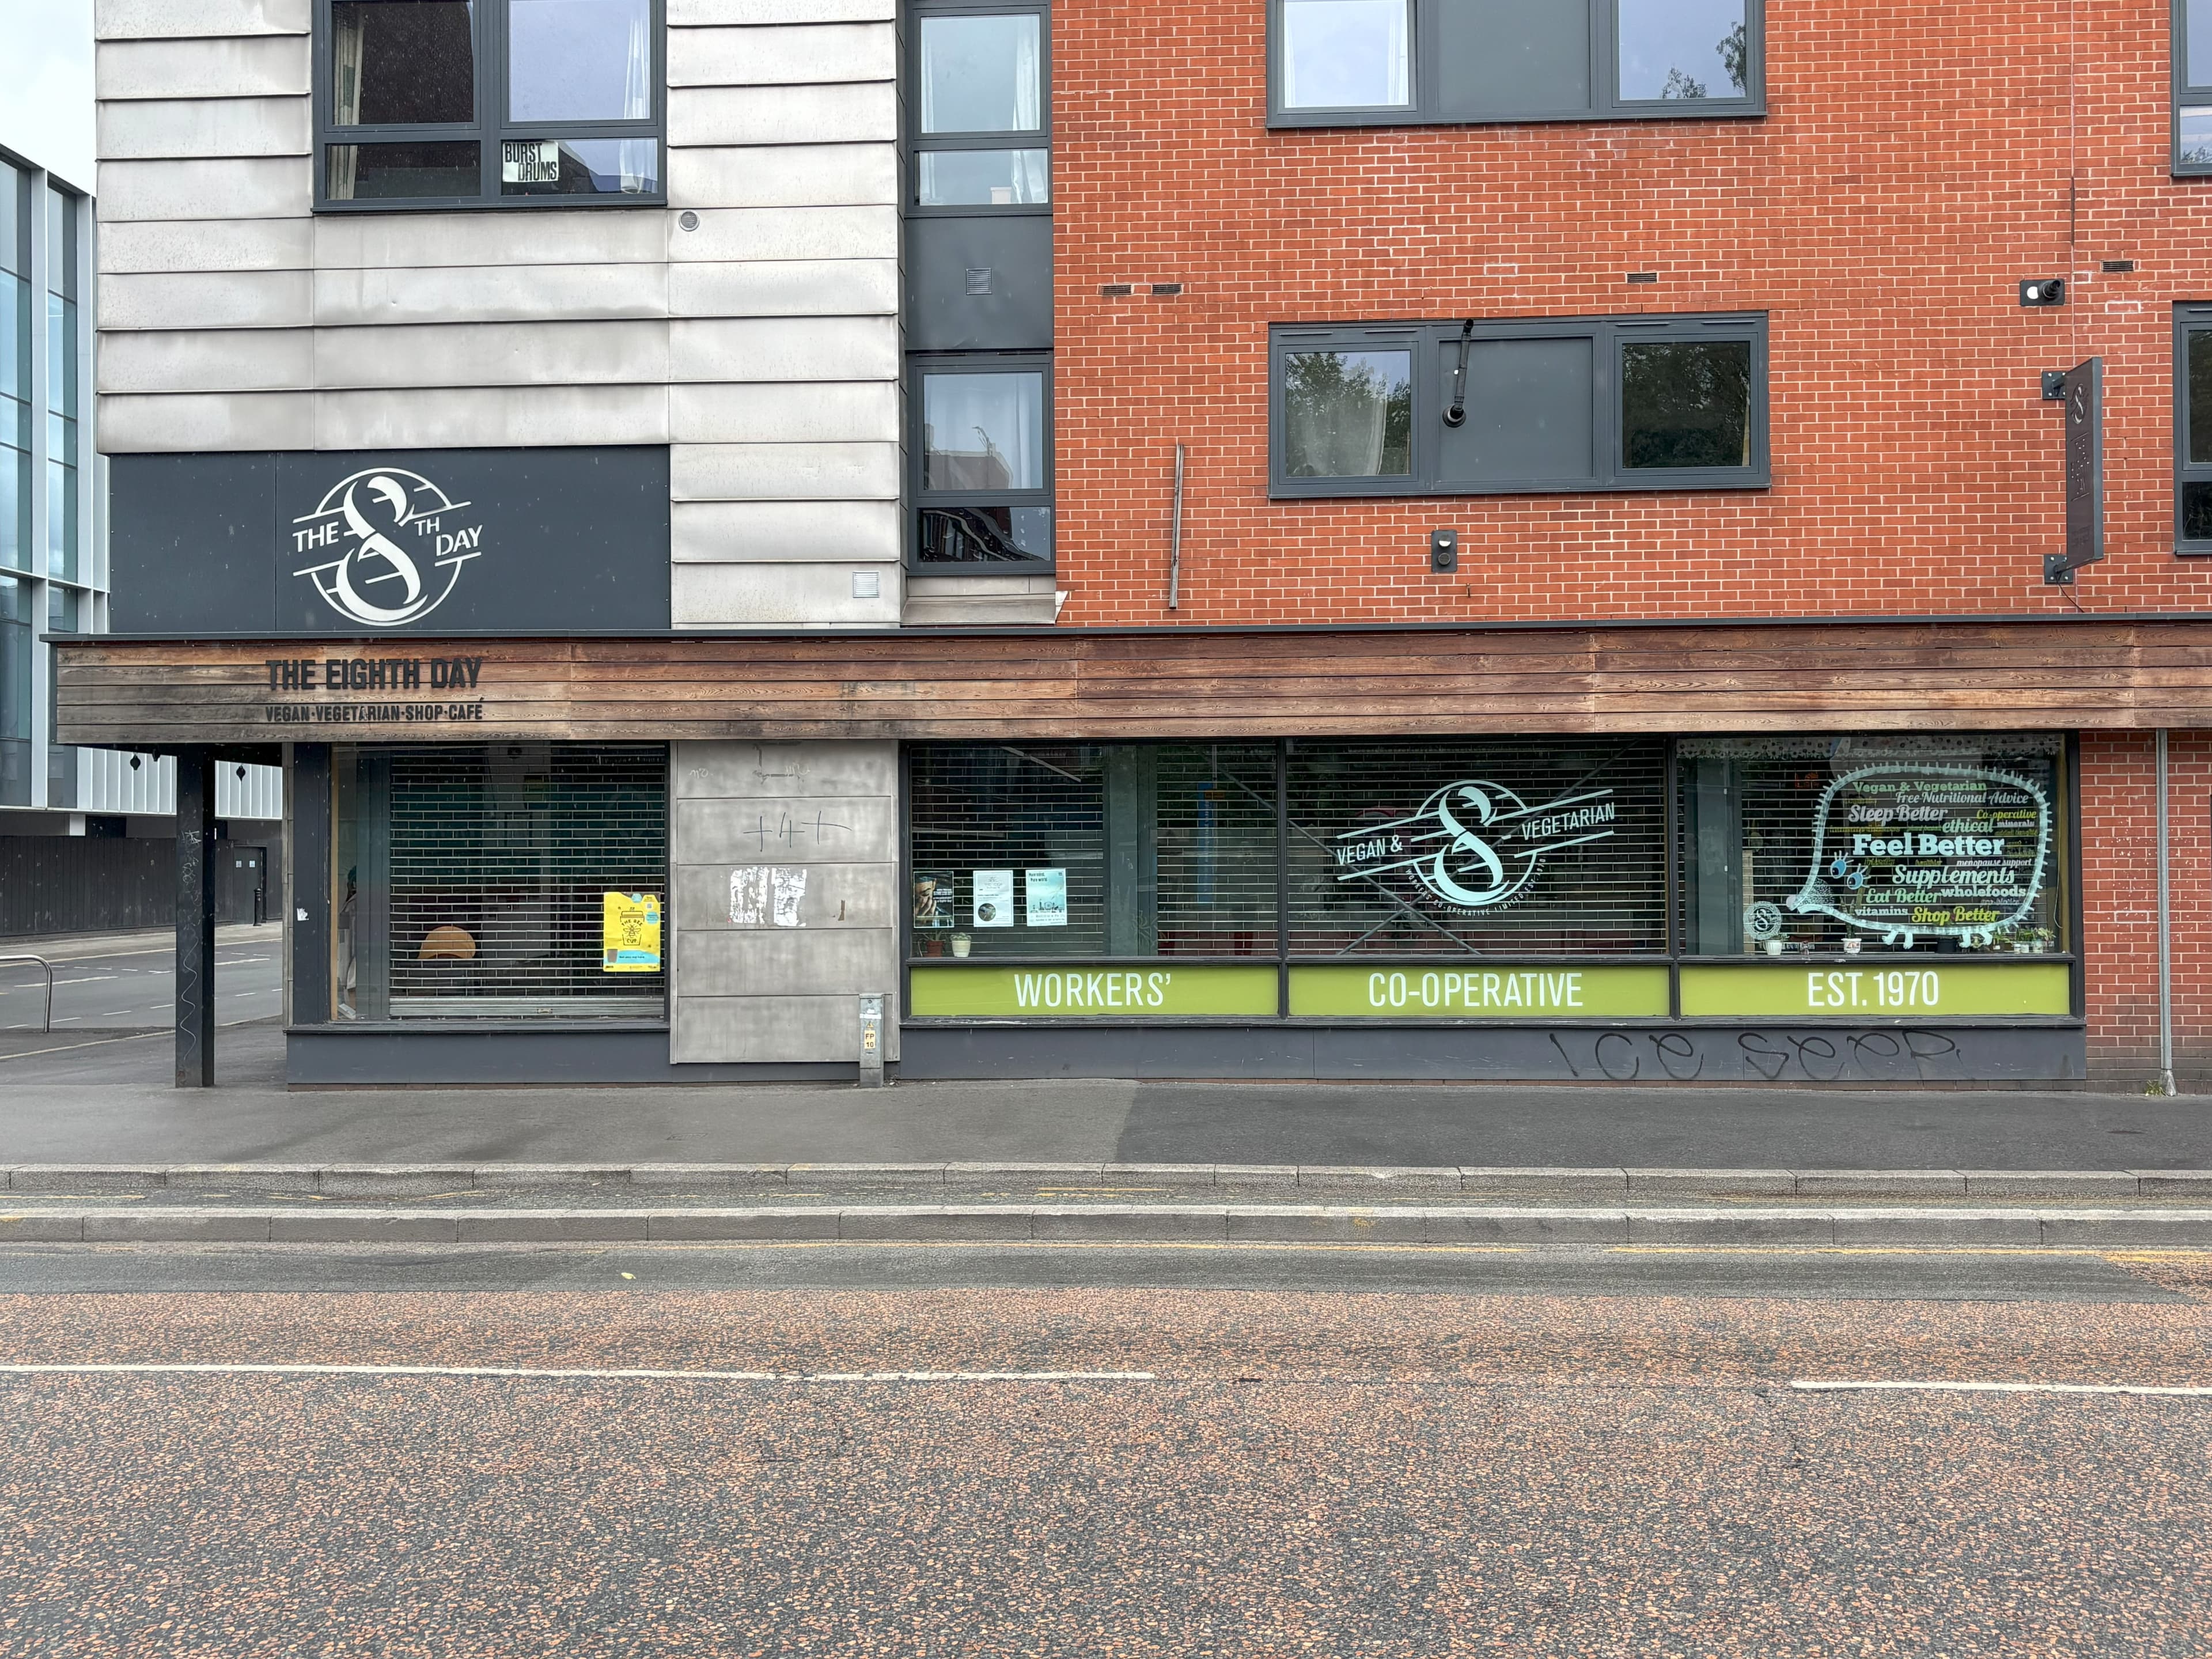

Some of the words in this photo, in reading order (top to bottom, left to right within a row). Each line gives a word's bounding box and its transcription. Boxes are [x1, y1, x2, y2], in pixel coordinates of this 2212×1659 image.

[505, 143, 542, 162] BURST
[518, 161, 557, 181] DRUMS
[292, 521, 339, 552] THE
[414, 516, 440, 536] TH
[436, 525, 483, 556] DAY
[266, 660, 316, 690] THE
[327, 658, 419, 690] EIGHTH
[430, 657, 482, 688] DAY
[1853, 782, 1896, 794] Vegan
[1900, 782, 1911, 791] &
[1914, 781, 1987, 793] Vegetarian
[1896, 791, 1920, 803] Free
[1921, 791, 1987, 803] Nutritional
[1987, 791, 2029, 805] Advice
[1848, 804, 1894, 827] Sleep
[1896, 804, 1948, 821] Better
[1942, 817, 1994, 834] ethical
[1976, 809, 2037, 821] Co-operative
[1336, 838, 1387, 866] VEGAN
[1390, 834, 1403, 853] &
[1521, 802, 1615, 841] VEGETARIAN
[1853, 832, 1914, 856] Feel
[1918, 834, 2005, 856] Better
[1957, 859, 2001, 869] menopause
[2002, 858, 2032, 869] support
[1892, 863, 2015, 889] Supplements
[1406, 868, 1433, 900] WORKERS
[1433, 899, 1490, 916] CO-OPERATIVE
[1494, 893, 1524, 911] LIMITED
[1866, 888, 1891, 903] Eat
[1895, 888, 1940, 903] Better
[1940, 884, 2027, 897] wholefoods
[1855, 906, 1908, 916] vitamins
[1912, 907, 1950, 926] Shop
[1953, 906, 2001, 922] Better
[1014, 972, 1171, 1007] WORKERS'
[1369, 972, 1584, 1007] CO-OPERATIVE
[1808, 972, 1867, 1006] EST.
[1873, 971, 1939, 1006] 1970
